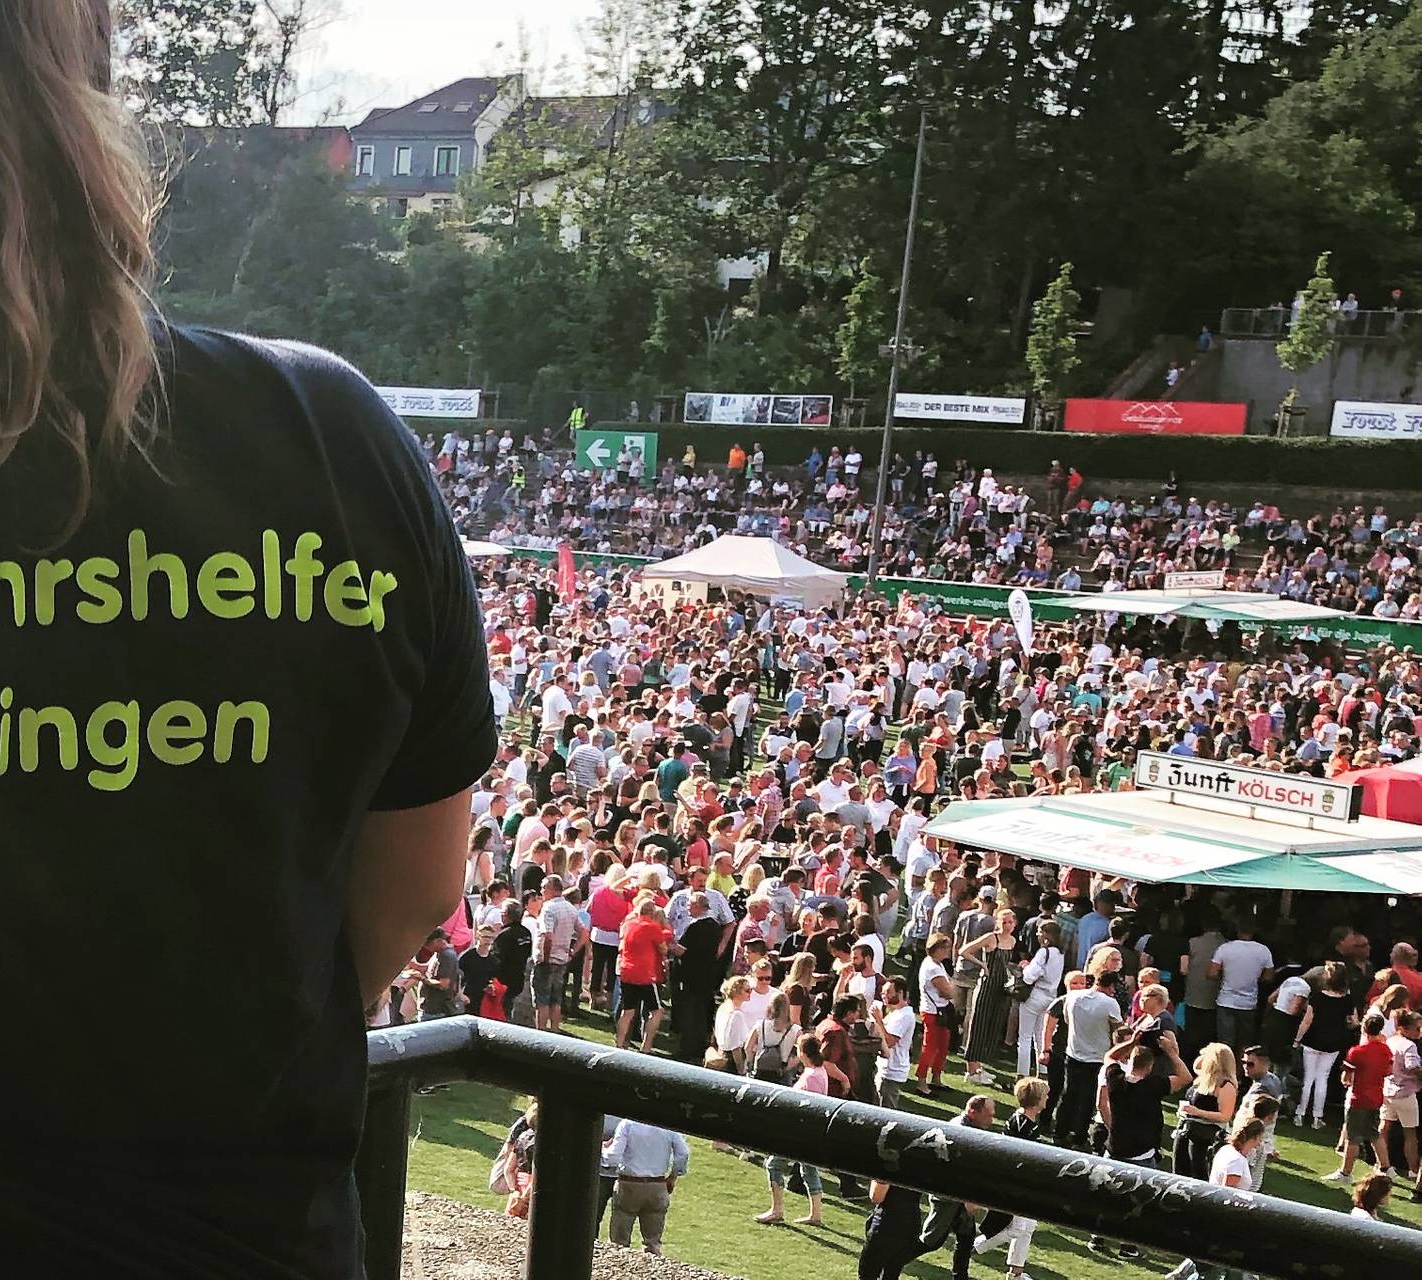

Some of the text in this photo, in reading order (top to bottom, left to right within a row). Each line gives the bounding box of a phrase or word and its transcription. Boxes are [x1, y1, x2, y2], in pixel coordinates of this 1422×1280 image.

[924, 402, 942, 411] DER
[943, 403, 971, 413] BESTE
[1168, 763, 1315, 808] Zunft KÖLSCH
